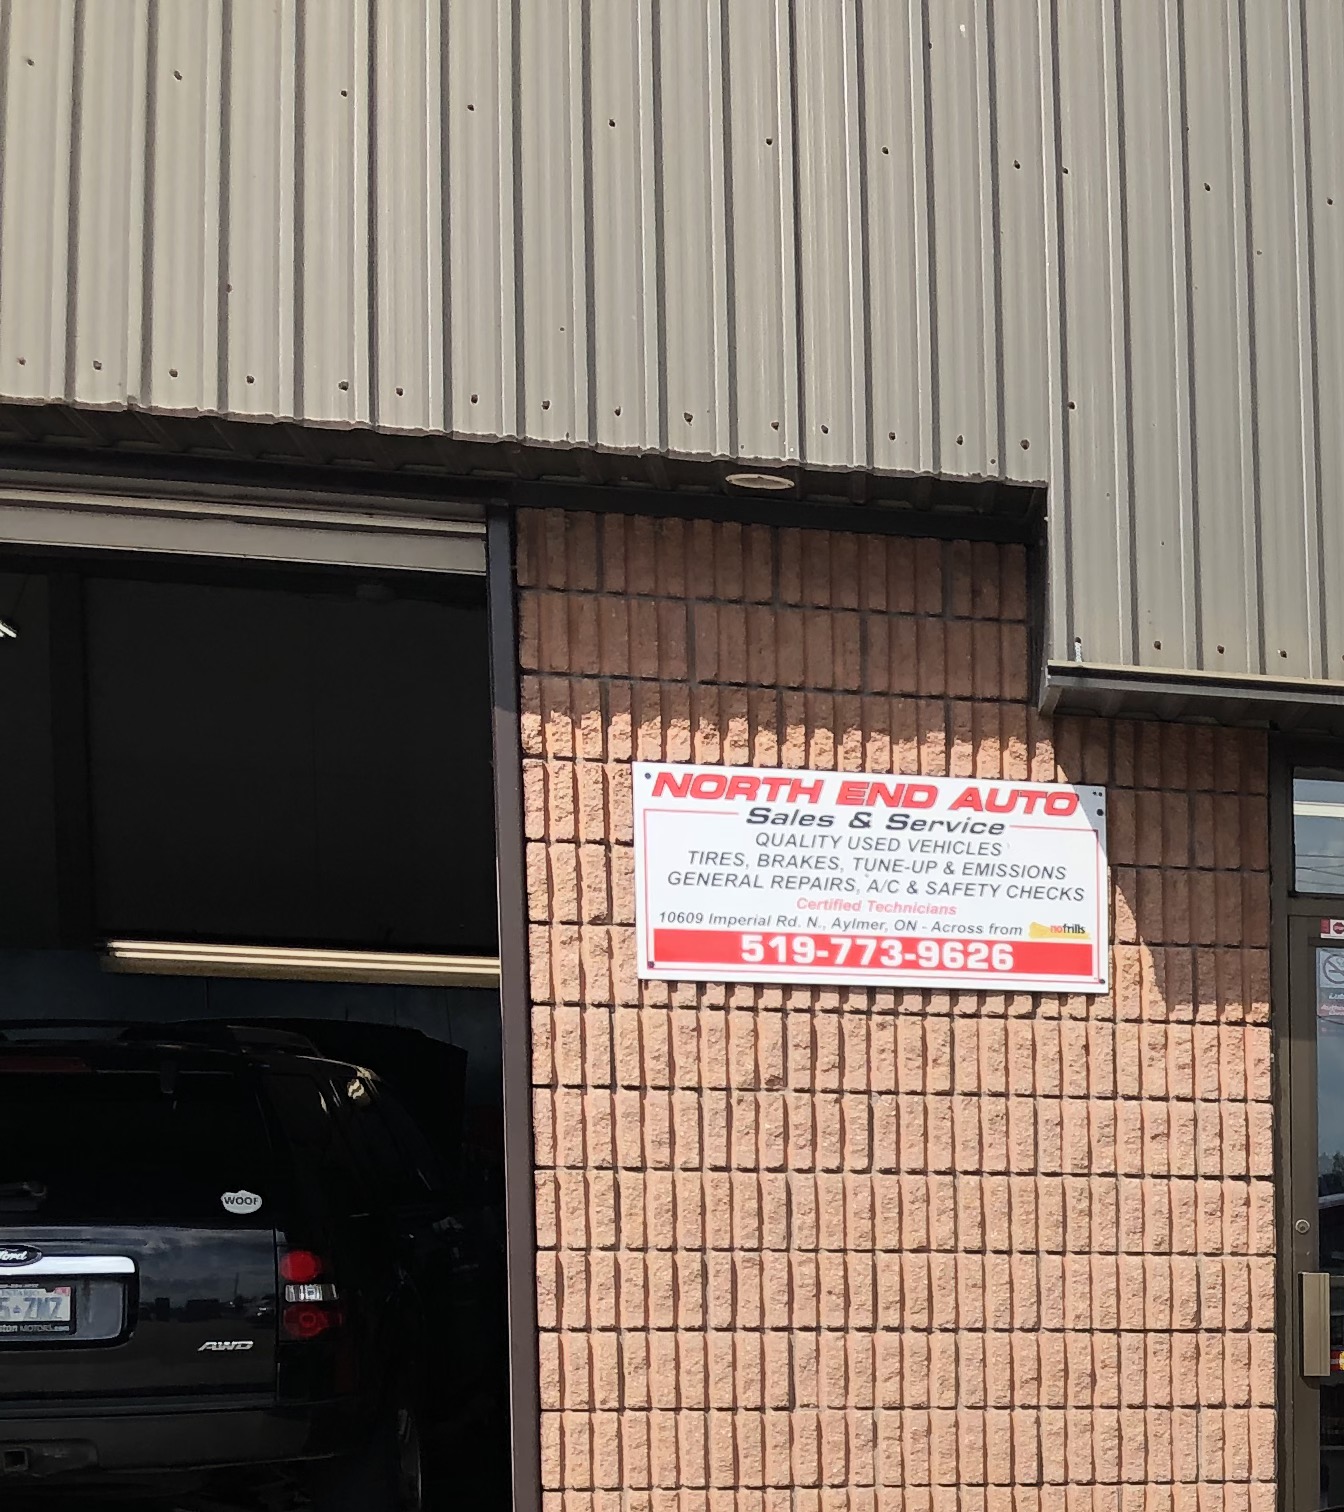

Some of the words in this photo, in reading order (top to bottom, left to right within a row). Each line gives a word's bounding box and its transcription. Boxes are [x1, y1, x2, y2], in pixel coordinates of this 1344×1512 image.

[651, 771, 825, 804] NORTH
[835, 780, 939, 809] END
[948, 787, 1080, 817] AUTO
[746, 807, 835, 830] Sales
[848, 811, 872, 829] &
[885, 813, 1005, 836] Service
[755, 832, 842, 850] QUALITY
[847, 836, 901, 852] USED
[908, 839, 1003, 857] VEHICLES
[688, 850, 750, 869] TIRES,
[756, 853, 844, 873] BRAKES,
[853, 857, 938, 875] TUNE-UP
[943, 861, 956, 876] &
[961, 862, 1067, 880] EMISSIONS
[667, 871, 765, 889] GENERAL
[770, 875, 861, 895] REPAIRS,
[867, 878, 900, 894] A/C
[906, 880, 919, 895] &
[925, 881, 1002, 898] SAFETY
[1006, 884, 1086, 902] CHECKS
[796, 897, 862, 912] Certified
[868, 900, 958, 916] Technicians
[659, 911, 704, 924] 10609
[708, 912, 772, 929] Imperial
[776, 914, 802, 928] Rd.
[831, 916, 889, 934] Aylmer,
[894, 919, 919, 932] ON
[931, 921, 983, 935] Across
[988, 922, 1023, 936] from
[740, 934, 1014, 971] 519-773-9626
[197, 1340, 254, 1352] AWD
